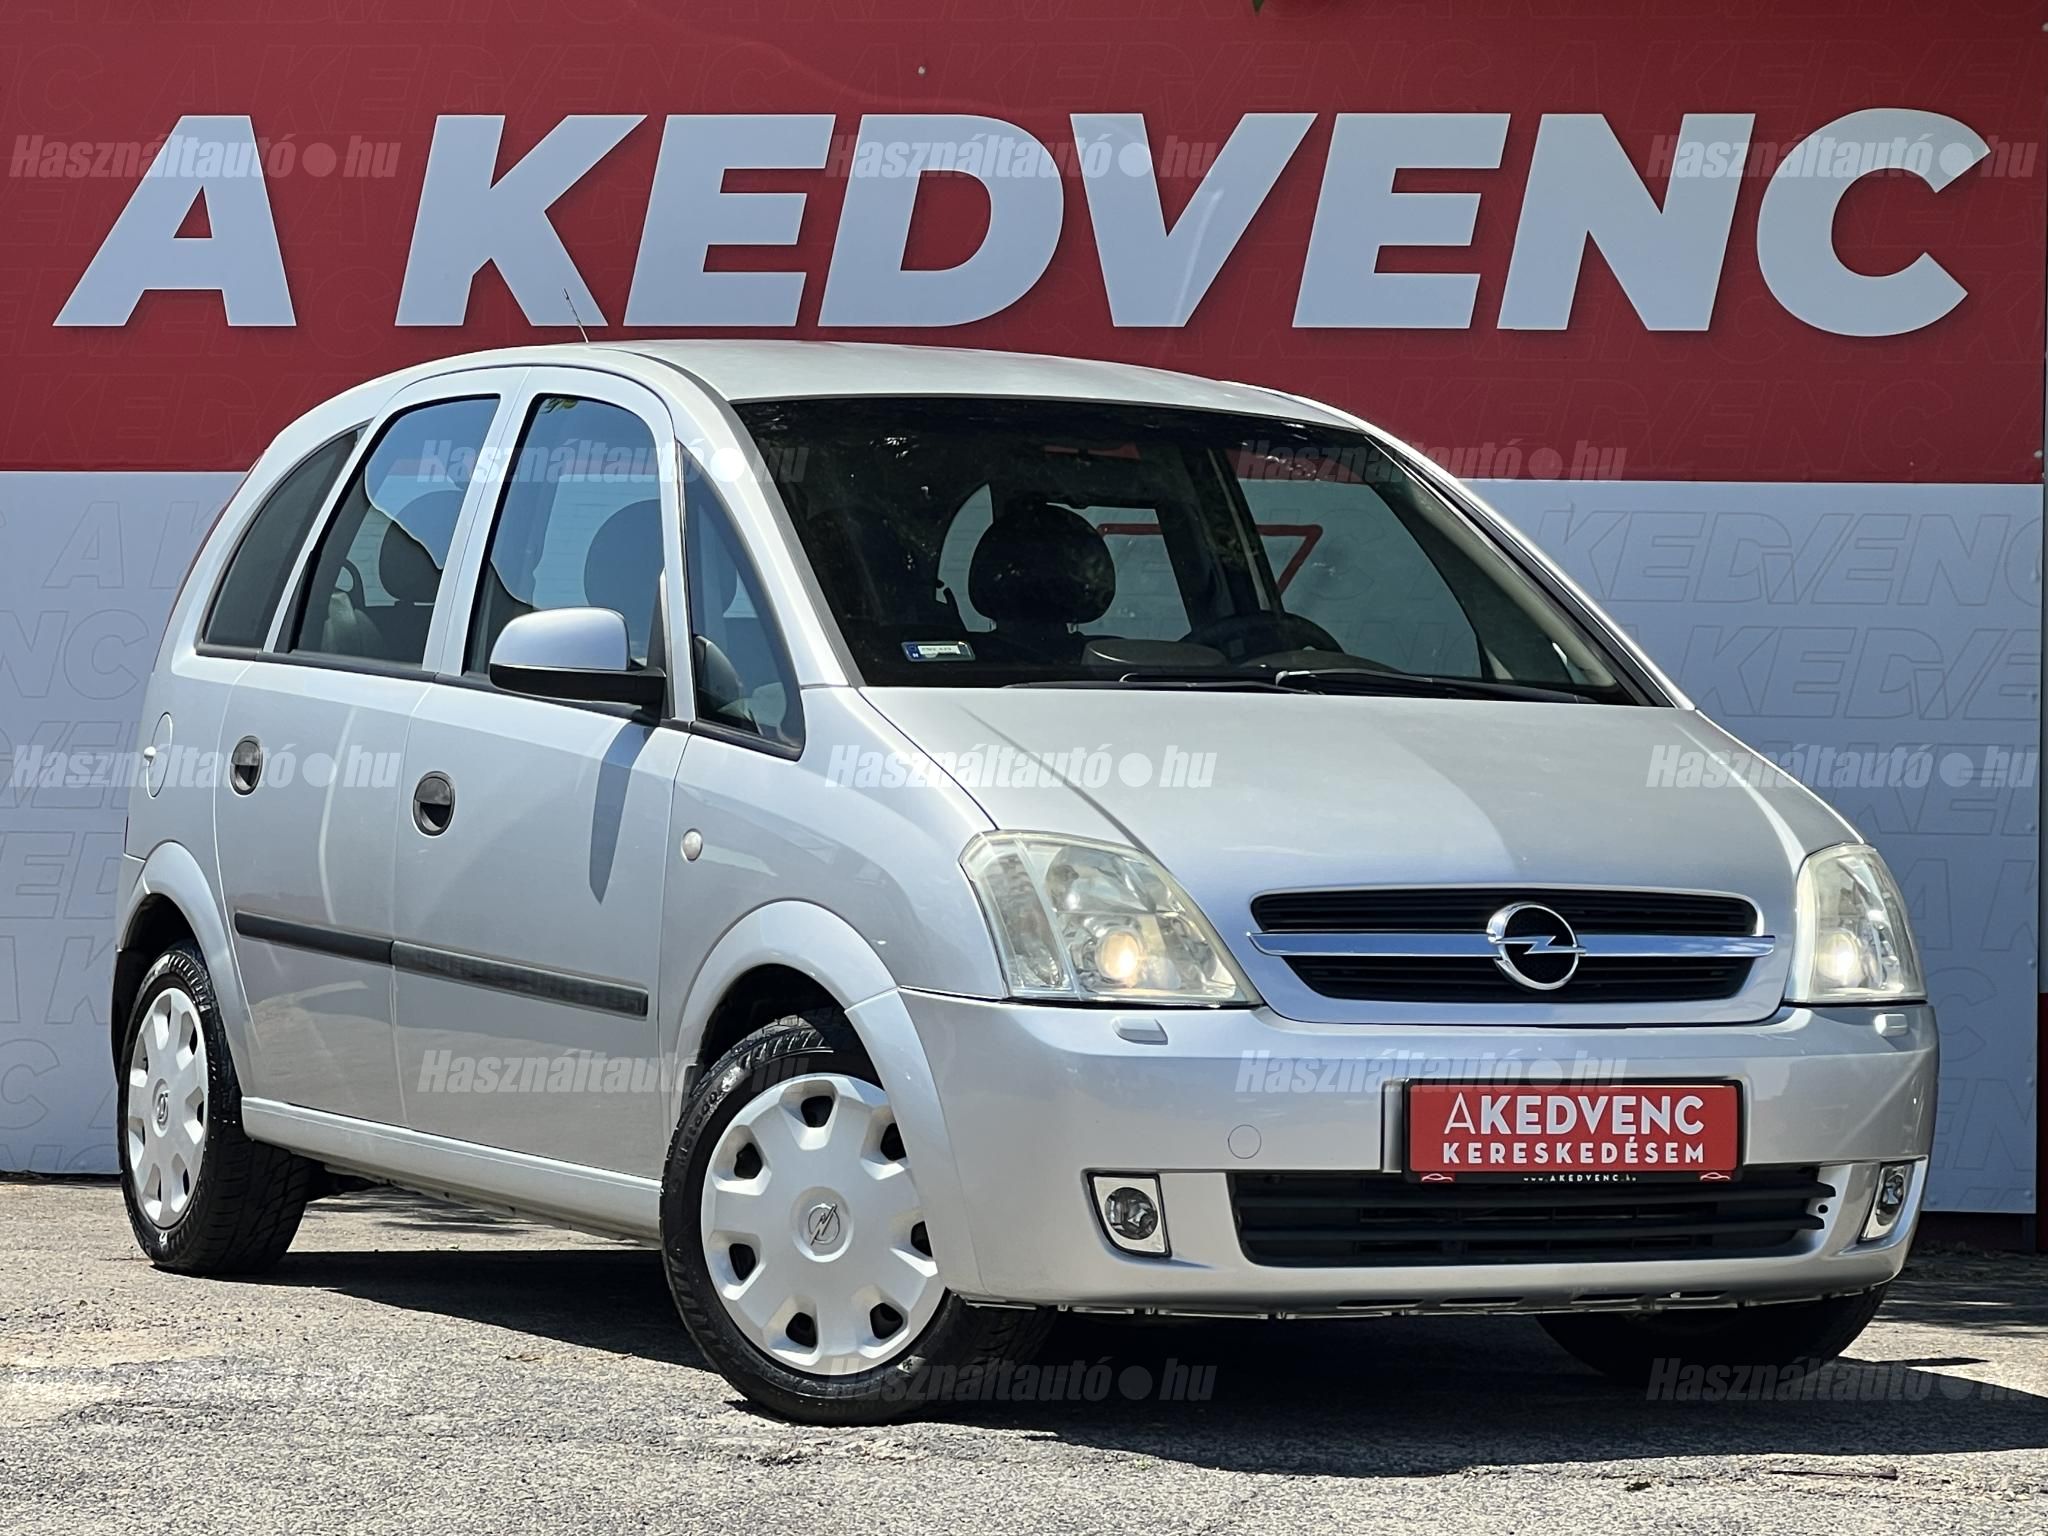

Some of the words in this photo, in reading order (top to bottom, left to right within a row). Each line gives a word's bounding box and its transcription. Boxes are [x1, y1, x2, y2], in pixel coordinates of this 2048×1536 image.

[53, 115, 297, 327] A
[394, 108, 1990, 337] KEDVENC
[1443, 1137, 1704, 1164] KERESKEDÉSEM
